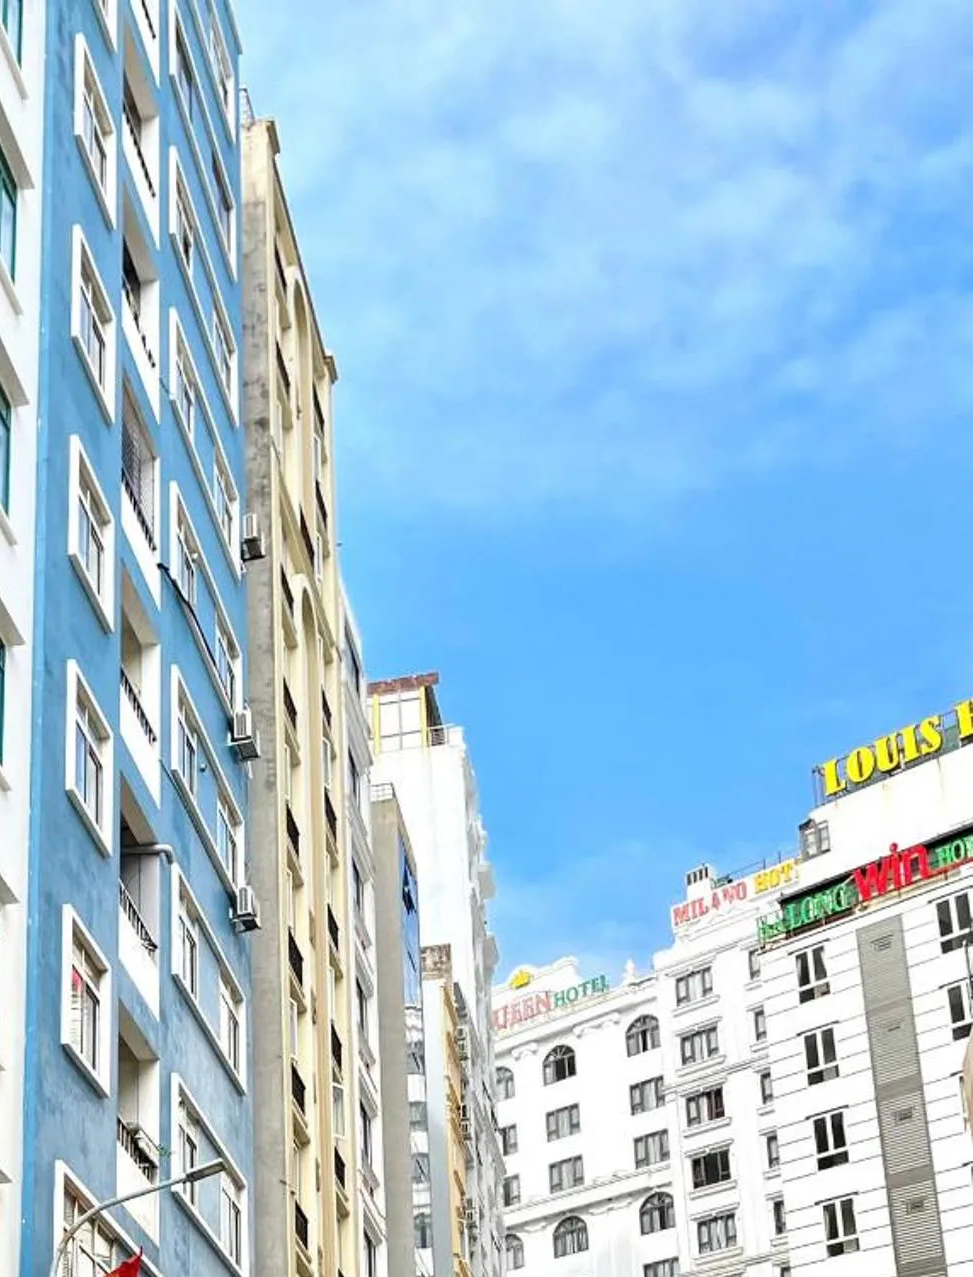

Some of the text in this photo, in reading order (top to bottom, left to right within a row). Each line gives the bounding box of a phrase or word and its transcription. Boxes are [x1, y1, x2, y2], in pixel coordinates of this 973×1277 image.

[822, 714, 943, 797] LOUIS
[673, 881, 748, 927] MILANO
[785, 883, 848, 929] LONG
[493, 974, 610, 1030] UEEN HOTEL
